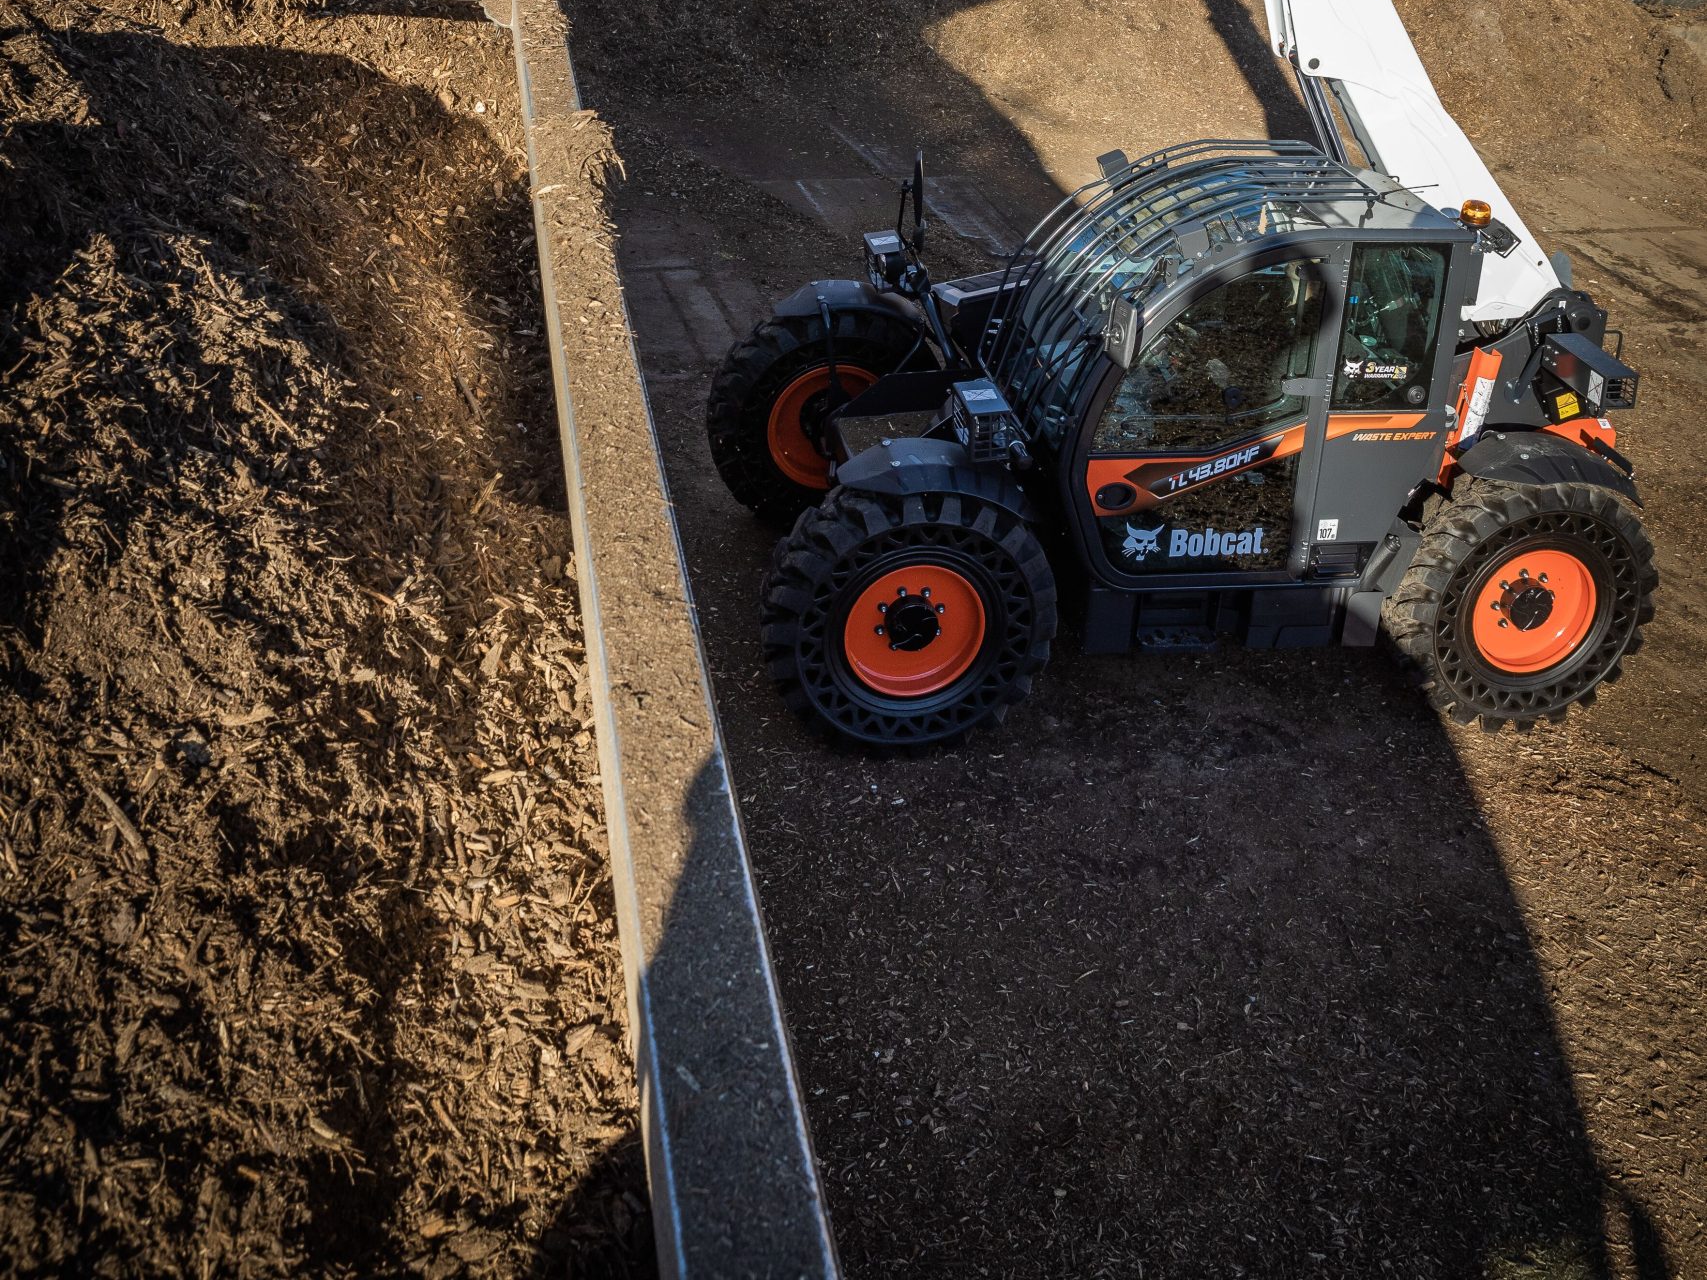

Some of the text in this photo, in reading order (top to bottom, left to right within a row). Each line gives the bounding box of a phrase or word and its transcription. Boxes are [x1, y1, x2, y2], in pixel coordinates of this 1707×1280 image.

[1365, 361, 1376, 373] 3
[1352, 431, 1436, 441] WASTE EXPERT
[1320, 528, 1332, 538] 107
[1168, 527, 1265, 558] Bobcat
